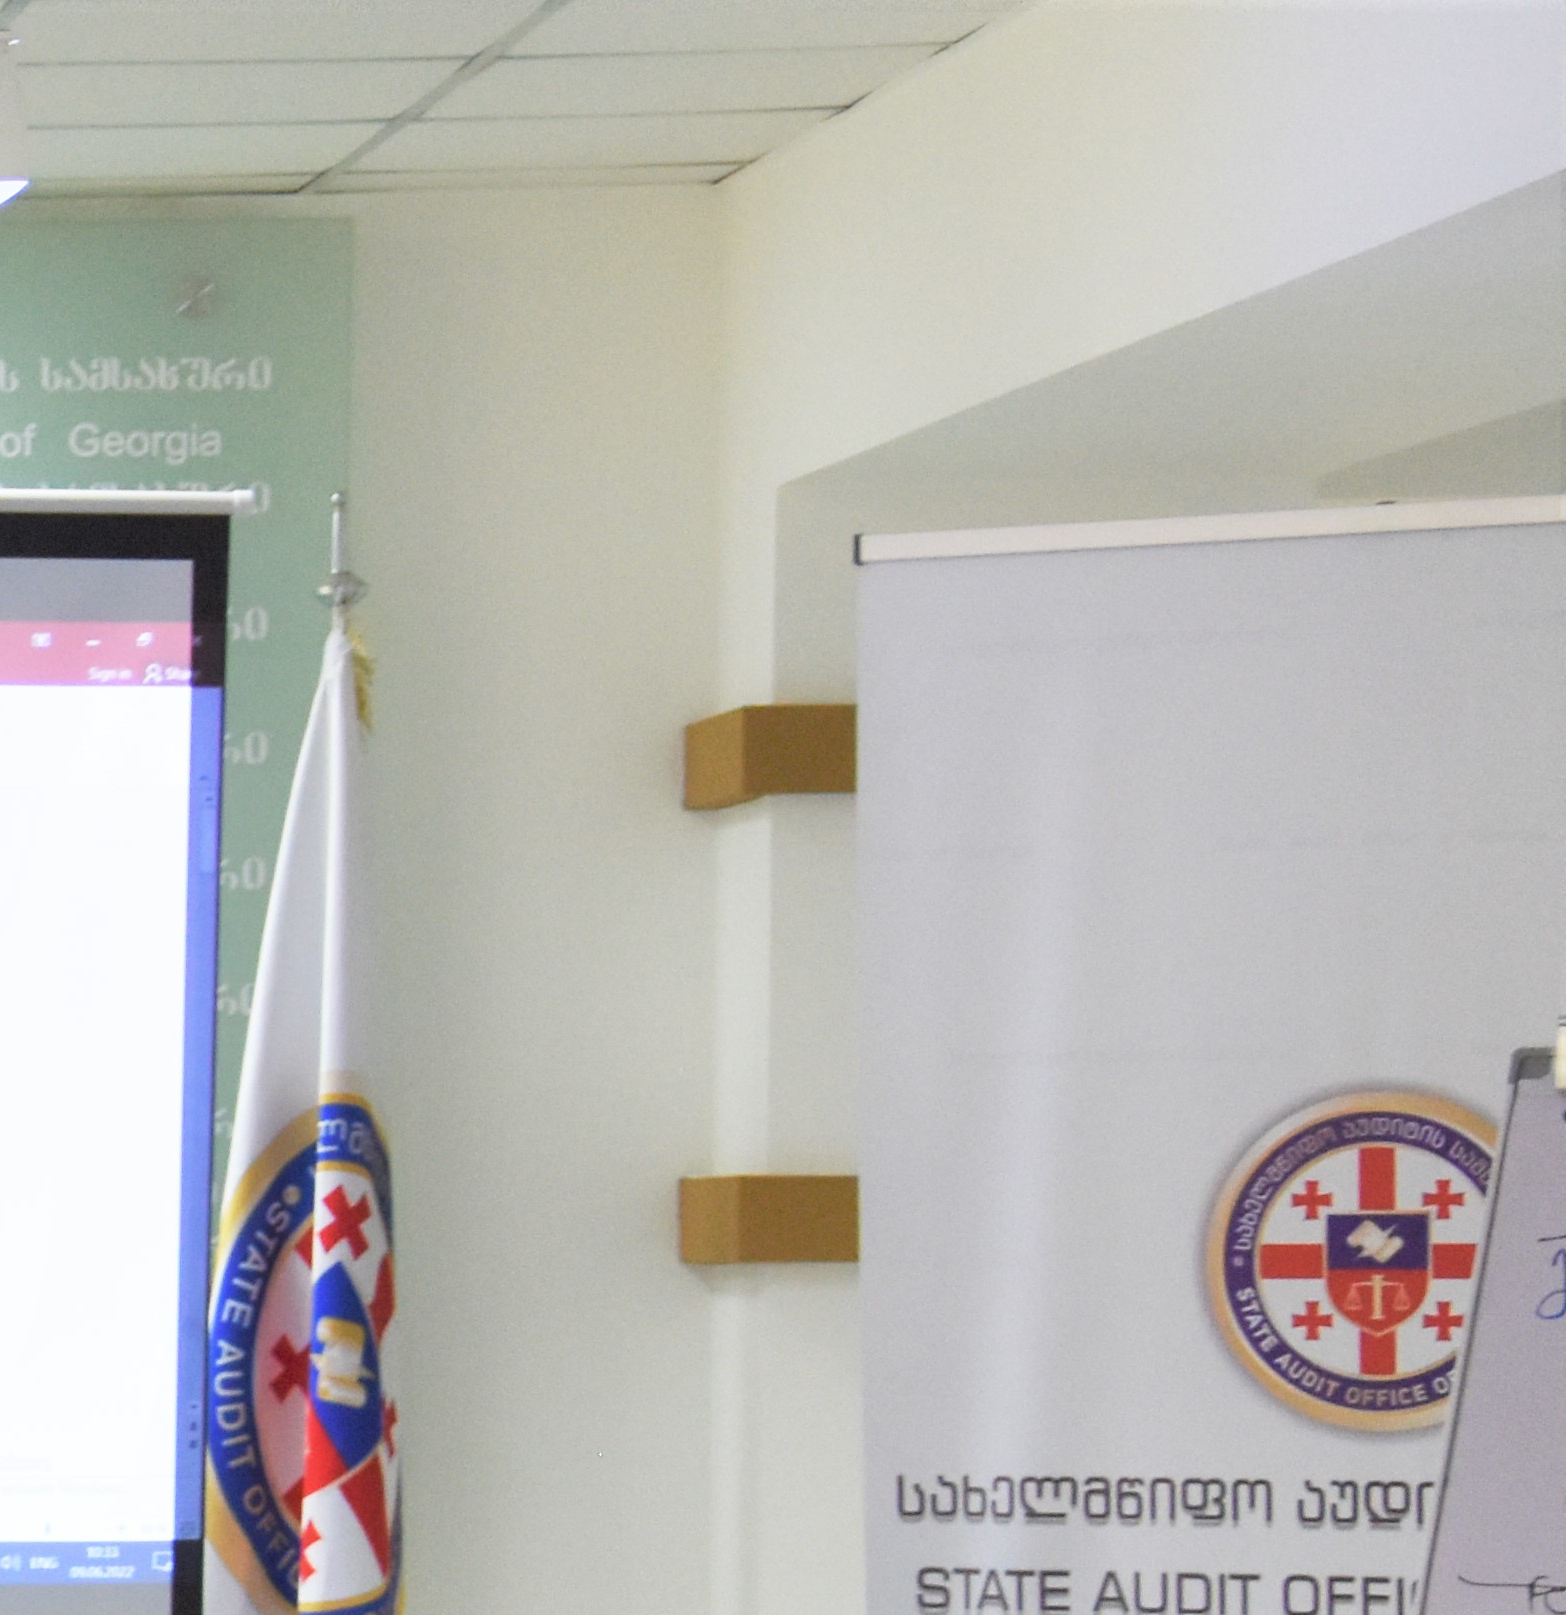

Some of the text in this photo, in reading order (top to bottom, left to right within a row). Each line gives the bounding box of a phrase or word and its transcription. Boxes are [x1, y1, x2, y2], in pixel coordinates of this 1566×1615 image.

[69, 422, 222, 465] Georgia
[220, 1201, 292, 1330] STATE
[213, 1339, 257, 1470] AUDIT
[1236, 1286, 1279, 1354] STATE
[1274, 1353, 1340, 1398] AUDIT
[1346, 1382, 1428, 1406] OFFICE
[915, 1566, 1071, 1615] STATE
